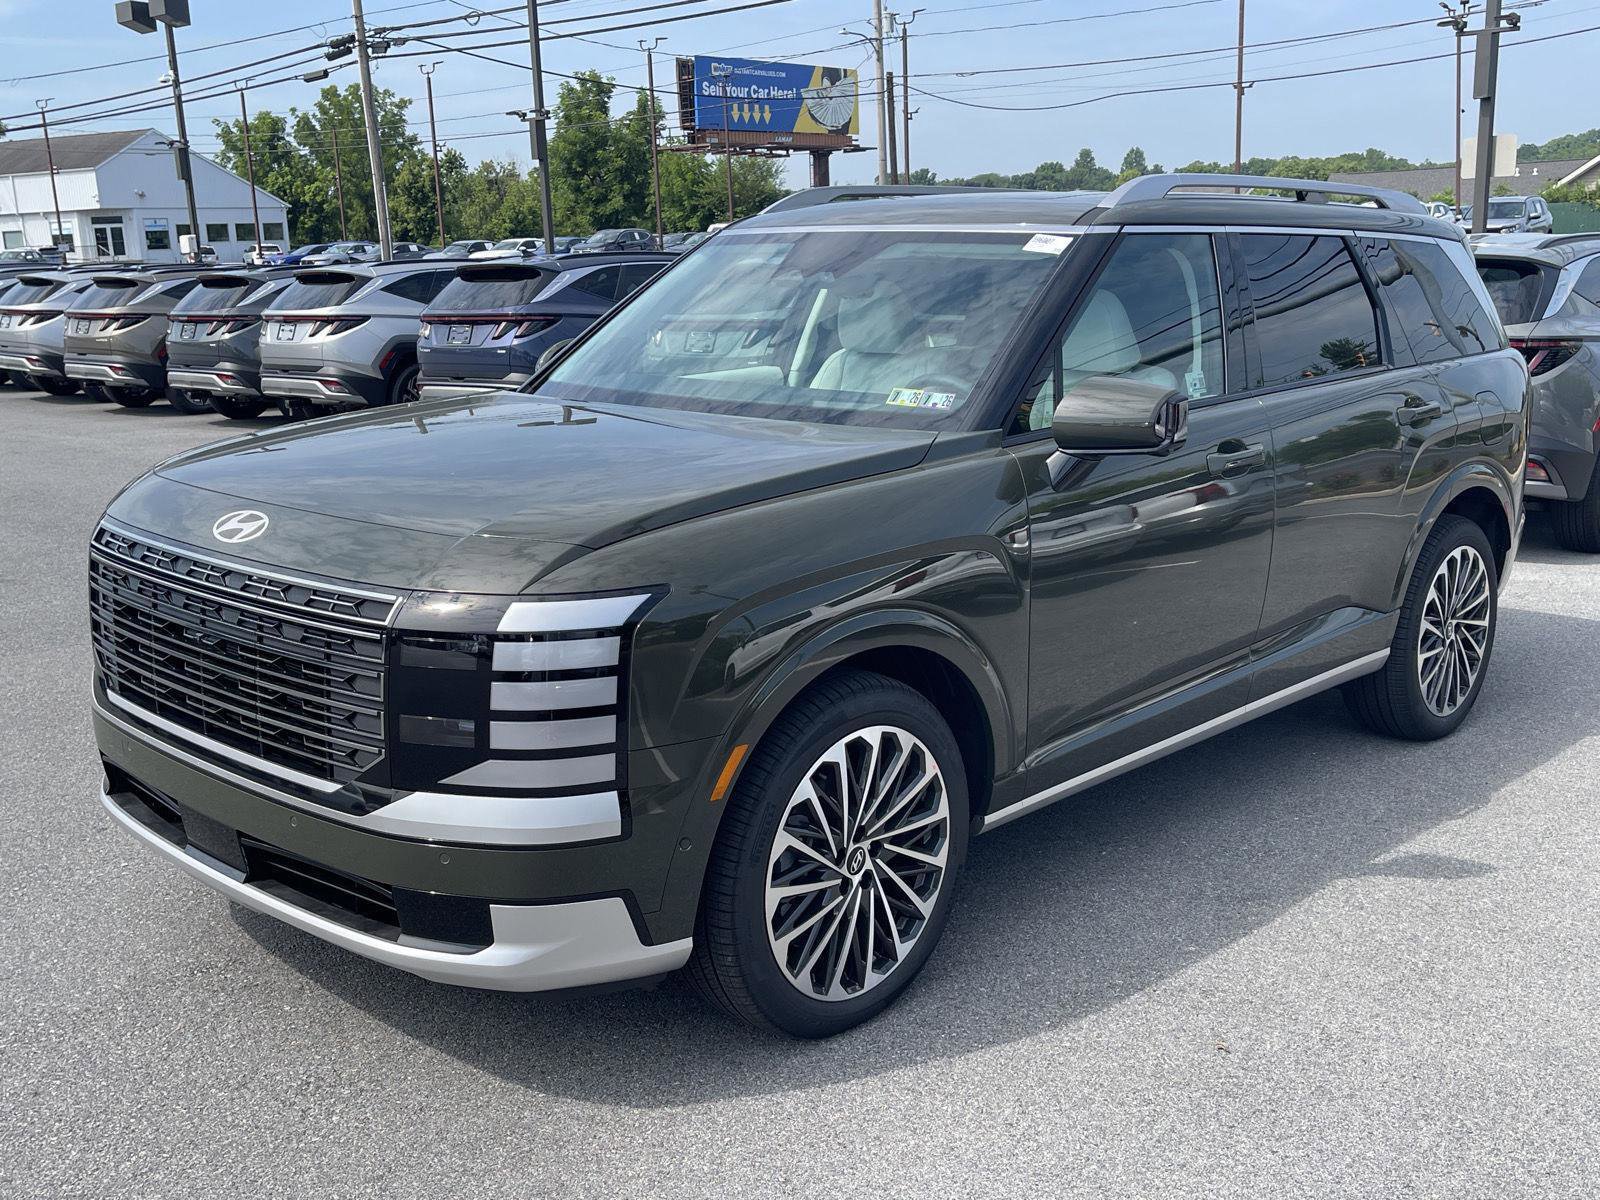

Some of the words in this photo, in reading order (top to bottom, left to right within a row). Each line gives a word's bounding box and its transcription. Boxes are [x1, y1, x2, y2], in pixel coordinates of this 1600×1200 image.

[702, 81, 723, 97] Sell
[725, 83, 749, 98] Your
[750, 85, 768, 99] Car
[770, 86, 797, 99] Here!
